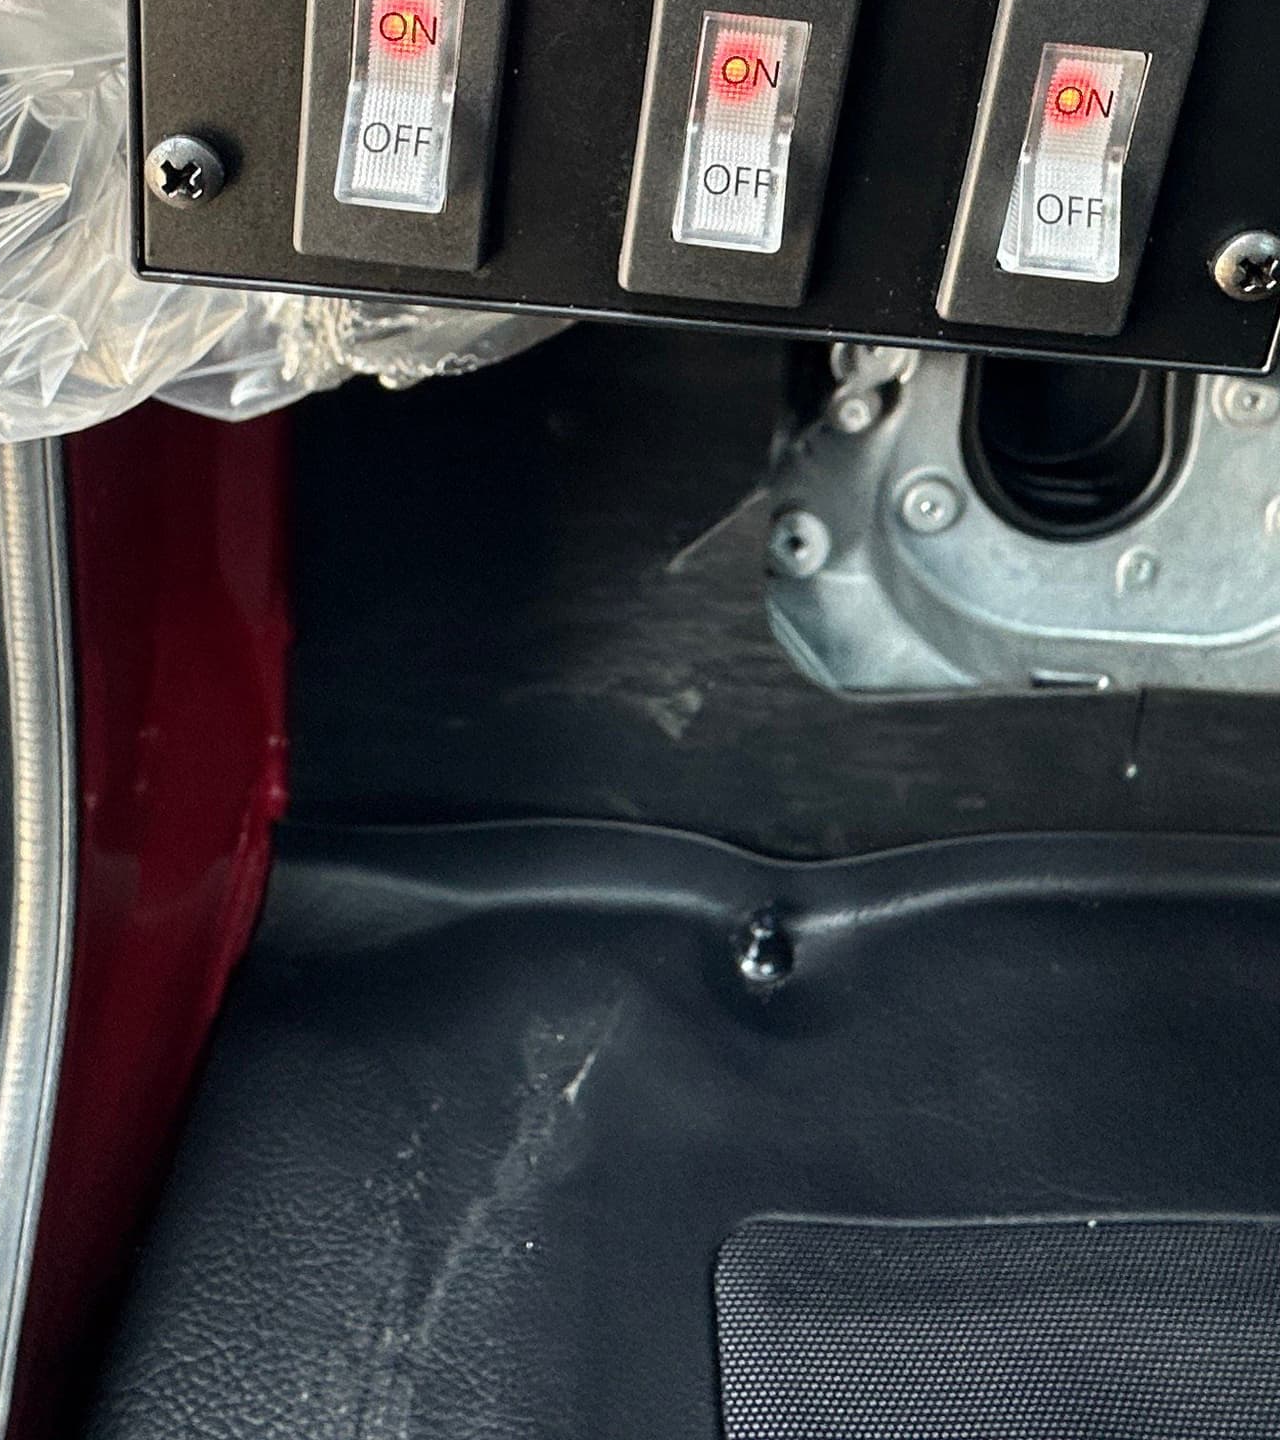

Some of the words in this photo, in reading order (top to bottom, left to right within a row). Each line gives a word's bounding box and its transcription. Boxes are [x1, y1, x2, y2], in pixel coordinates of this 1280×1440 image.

[378, 10, 438, 45] ON
[720, 54, 781, 90] ON
[1054, 83, 1113, 118] ON
[362, 122, 432, 157] OFF
[703, 164, 772, 200] OFF
[1036, 192, 1104, 229] OFF
